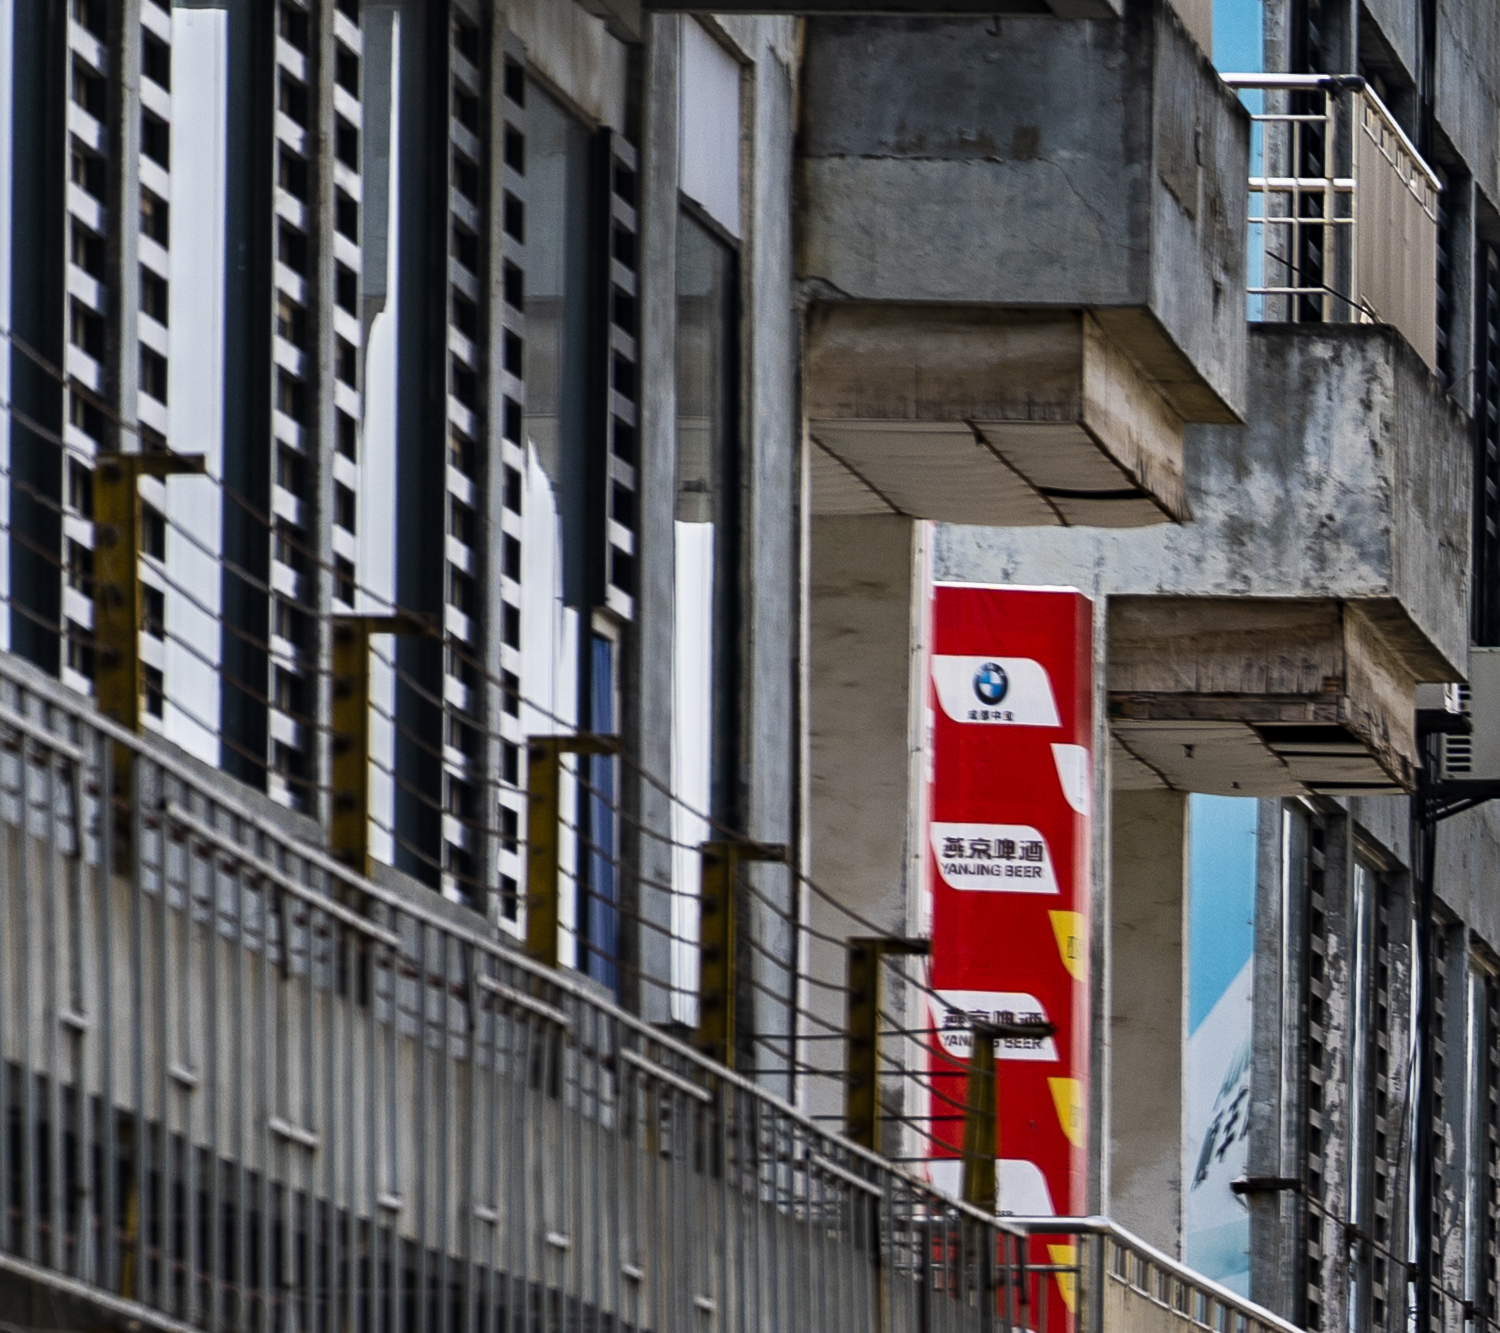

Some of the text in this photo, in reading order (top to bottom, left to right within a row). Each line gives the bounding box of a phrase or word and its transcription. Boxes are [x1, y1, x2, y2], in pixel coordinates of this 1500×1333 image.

[942, 837, 1043, 862] 燕京啤酒
[942, 863, 1042, 878] YANJING BEER
